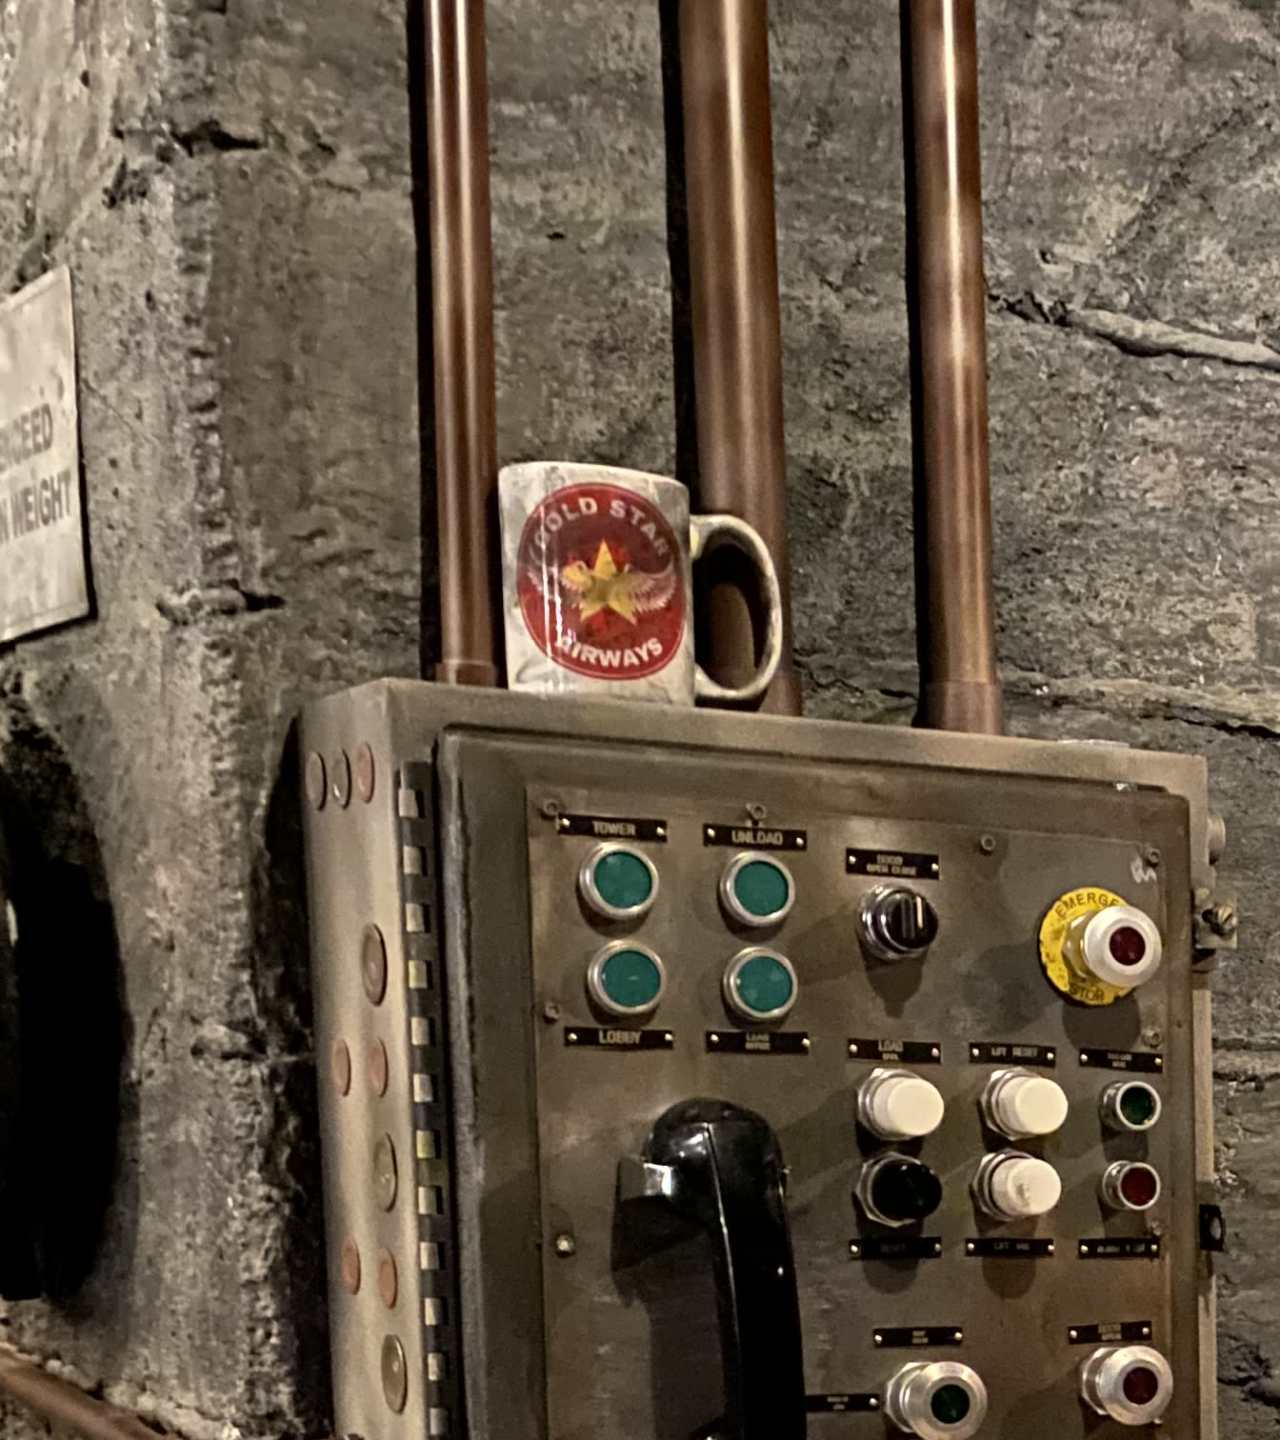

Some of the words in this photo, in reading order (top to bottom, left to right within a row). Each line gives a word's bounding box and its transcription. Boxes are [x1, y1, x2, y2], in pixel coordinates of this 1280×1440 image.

[11, 469, 72, 538] WEIGHT
[533, 496, 599, 548] GOLD
[609, 500, 672, 557] STAR
[555, 634, 664, 668] AIRWAYS
[592, 821, 636, 836] TOWER
[731, 830, 784, 845] UNLOAD
[598, 1029, 642, 1045] LOBBY
